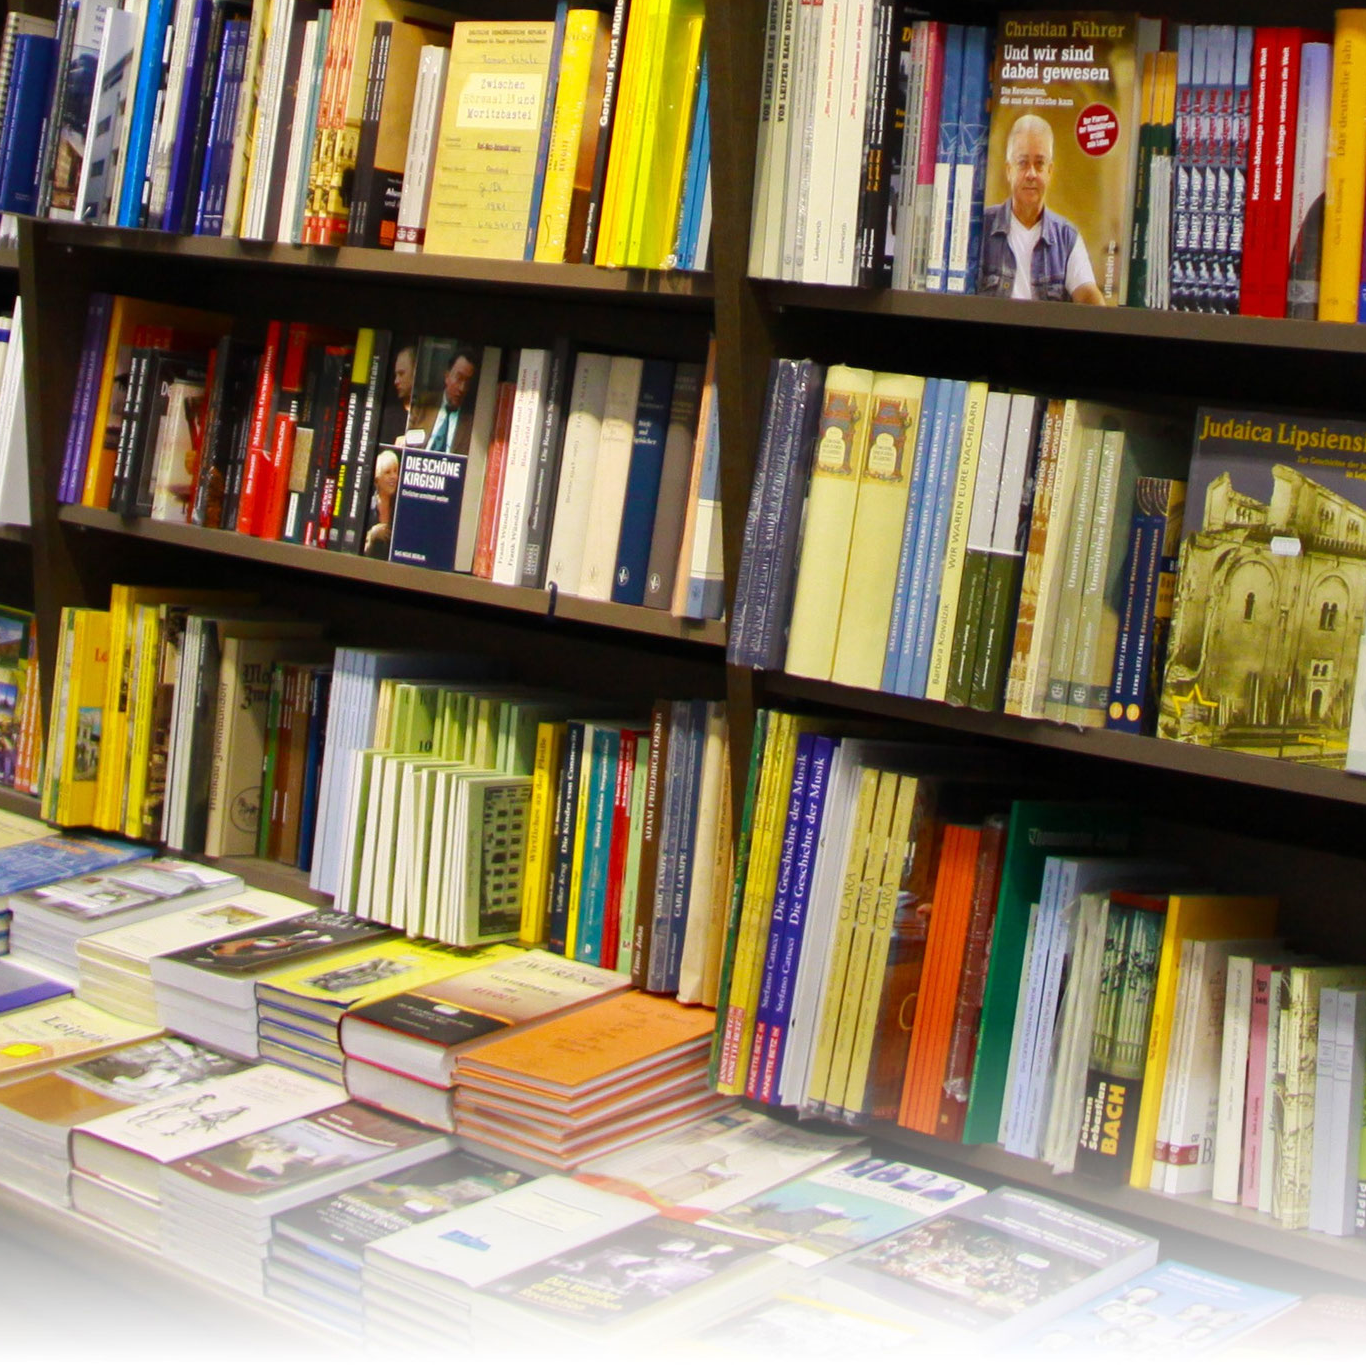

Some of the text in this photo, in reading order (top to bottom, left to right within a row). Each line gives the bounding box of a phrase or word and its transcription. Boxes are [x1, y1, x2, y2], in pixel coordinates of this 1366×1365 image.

[1005, 22, 1125, 38] Christian Führer
[1003, 45, 1094, 62] Und wir sind
[481, 80, 525, 90] Zwischen
[599, 72, 614, 127] Gerhard
[607, 36, 619, 69] Kurt
[1001, 63, 1109, 83] dabei gewesen
[467, 108, 532, 120] Moritzbastei
[517, 96, 535, 105] und
[1340, 70, 1351, 131] deutsche
[1252, 125, 1264, 200] Kerzen-Montage
[1258, 81, 1266, 122] verändern
[1338, 134, 1346, 156] Das
[1274, 125, 1286, 200] Kerzen-Montage
[1105, 256, 1114, 298] ullstein
[1200, 416, 1272, 443] Judaica
[403, 471, 445, 491] KIRGISIN
[405, 455, 461, 477] DIE SCHÖNE
[932, 400, 978, 685] Barbara Kowalzik WIR WAREN EURE NACHBARN
[649, 748, 660, 803] FRIEDRICH
[793, 753, 807, 796] Musik
[810, 757, 825, 798] Musik
[645, 805, 655, 842] ADAM
[790, 798, 801, 821] der
[806, 802, 818, 824] der
[777, 824, 797, 894] Geschichte
[793, 827, 813, 897] Geschichte
[773, 898, 785, 921] Die
[789, 902, 801, 926] Die
[840, 872, 857, 921] CLARA
[858, 876, 875, 926] CLARA
[877, 882, 894, 930] CLARA
[761, 971, 774, 1008] Stefano
[775, 976, 789, 1013] Stefano
[748, 1056, 761, 1093] ANNETTE
[763, 1060, 775, 1098] ANNETTE
[1080, 1096, 1093, 1148] Johann
[1089, 1082, 1107, 1150] Sebastian
[1100, 1084, 1125, 1155] BACH
[1356, 1183, 1366, 1228] PIPER
